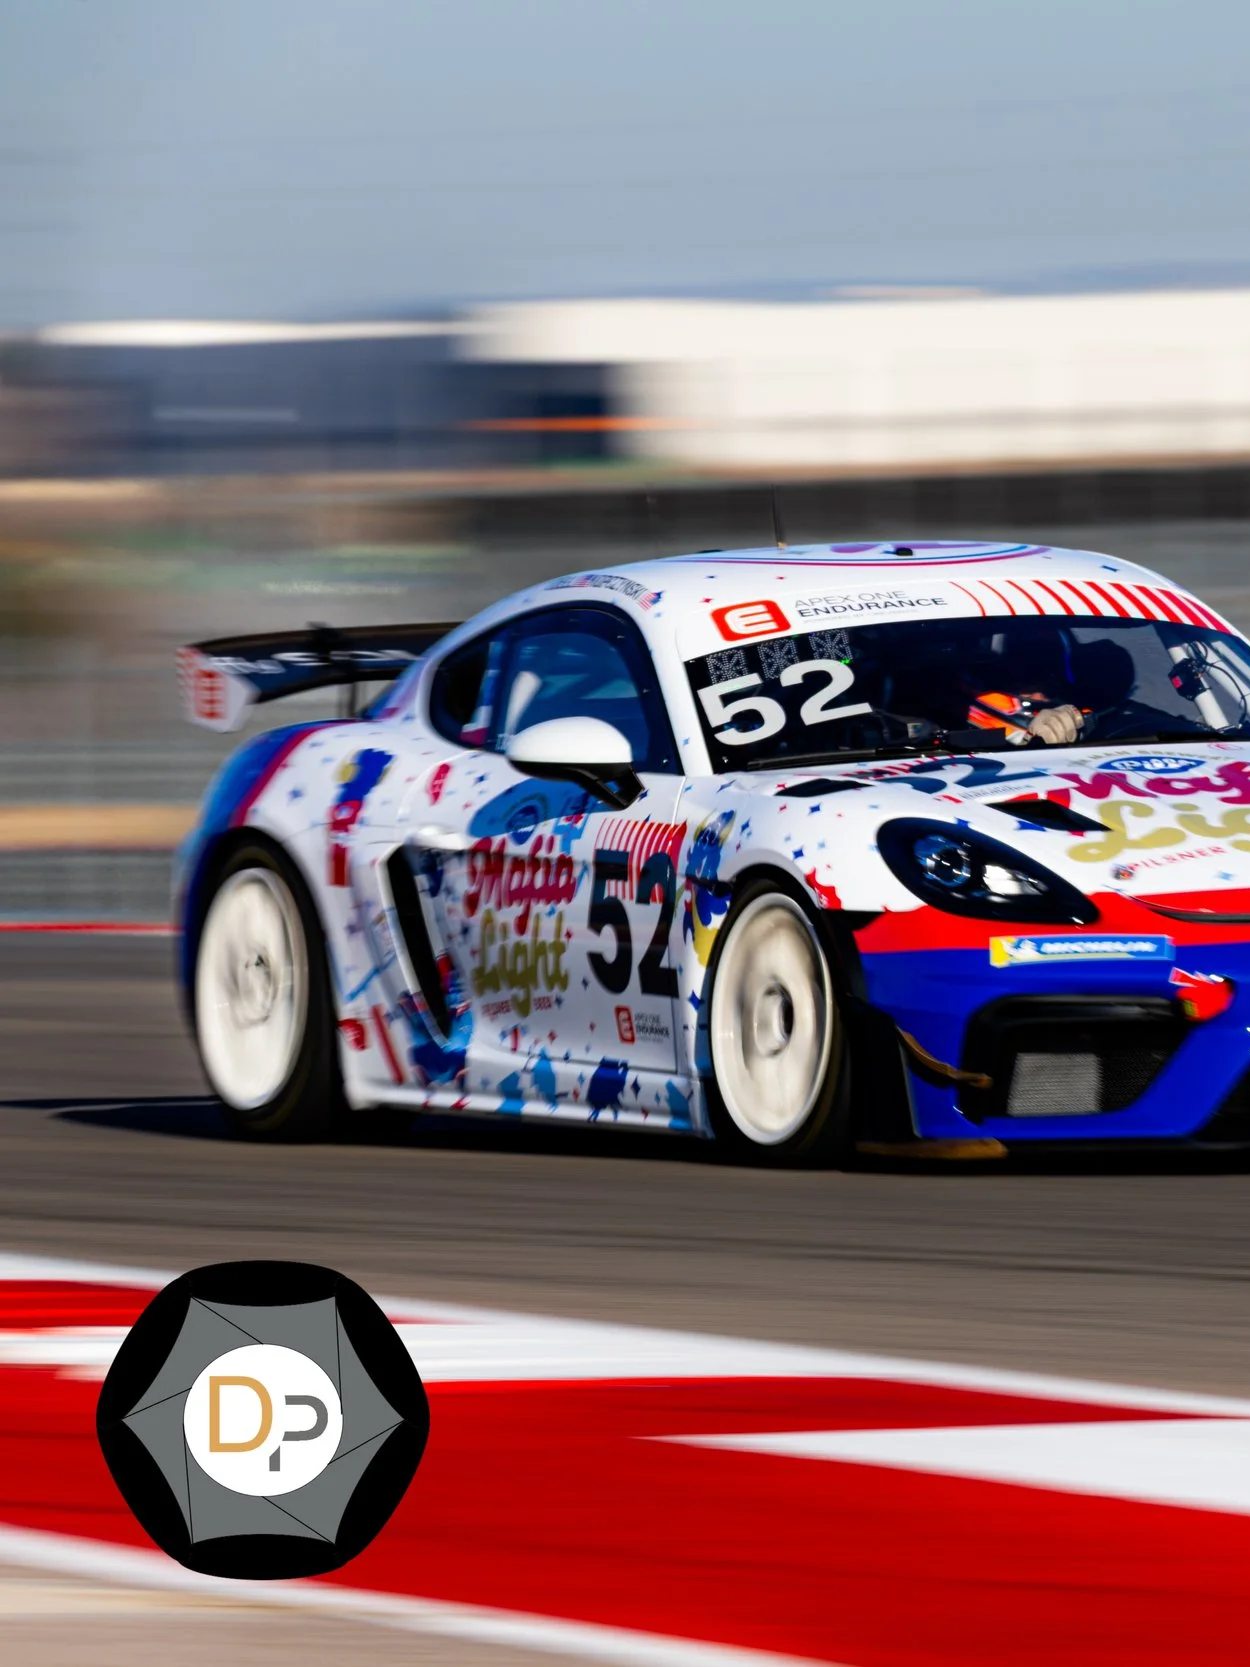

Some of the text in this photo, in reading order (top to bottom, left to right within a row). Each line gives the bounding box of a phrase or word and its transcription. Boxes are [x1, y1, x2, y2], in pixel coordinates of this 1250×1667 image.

[795, 590, 909, 608] APEX ONE
[797, 597, 948, 617] ENDURANCE
[697, 659, 873, 745] 52
[463, 835, 577, 936] Mafia
[1128, 846, 1226, 872] PILSNER
[471, 908, 569, 1018] Light
[587, 848, 680, 999] 52
